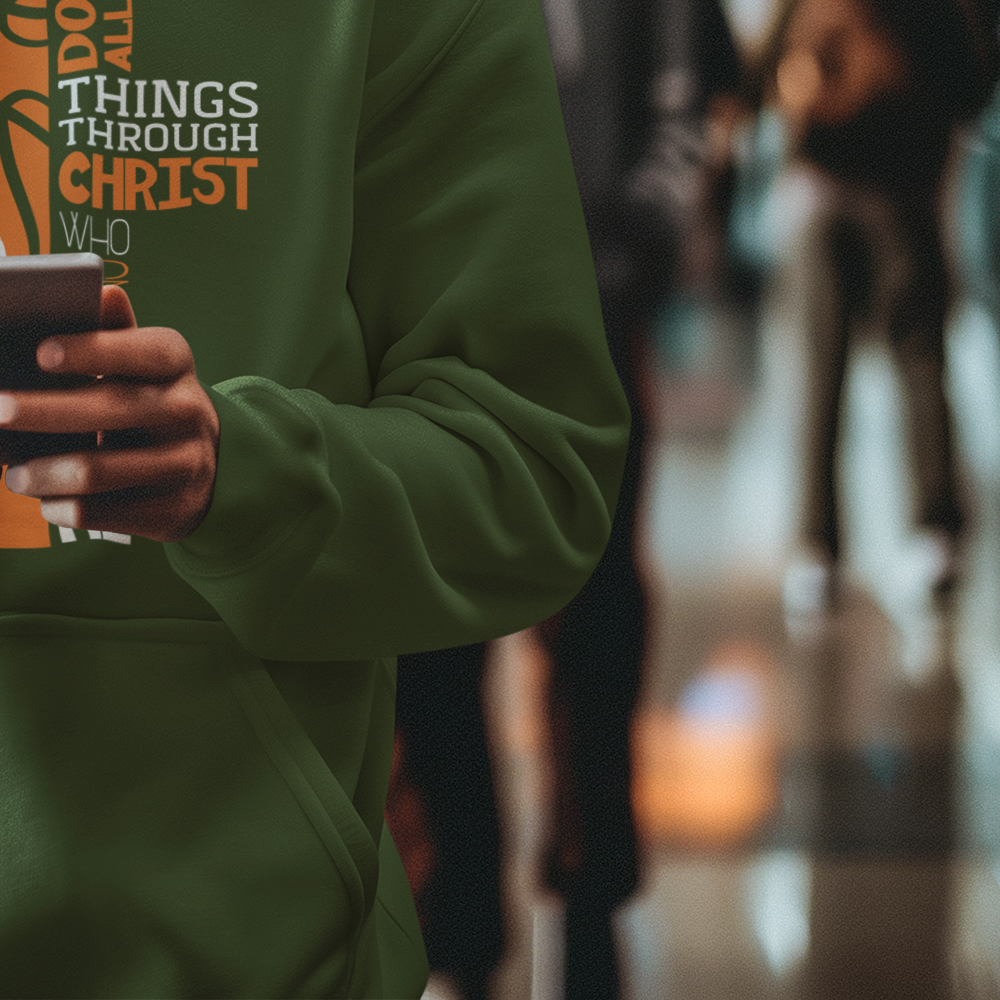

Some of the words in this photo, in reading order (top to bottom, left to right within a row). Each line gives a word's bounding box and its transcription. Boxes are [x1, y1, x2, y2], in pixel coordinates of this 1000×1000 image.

[58, 75, 258, 118] THINGS
[58, 117, 258, 151] THROUGH
[58, 151, 258, 210] CHRIST
[59, 211, 130, 255] WHO
